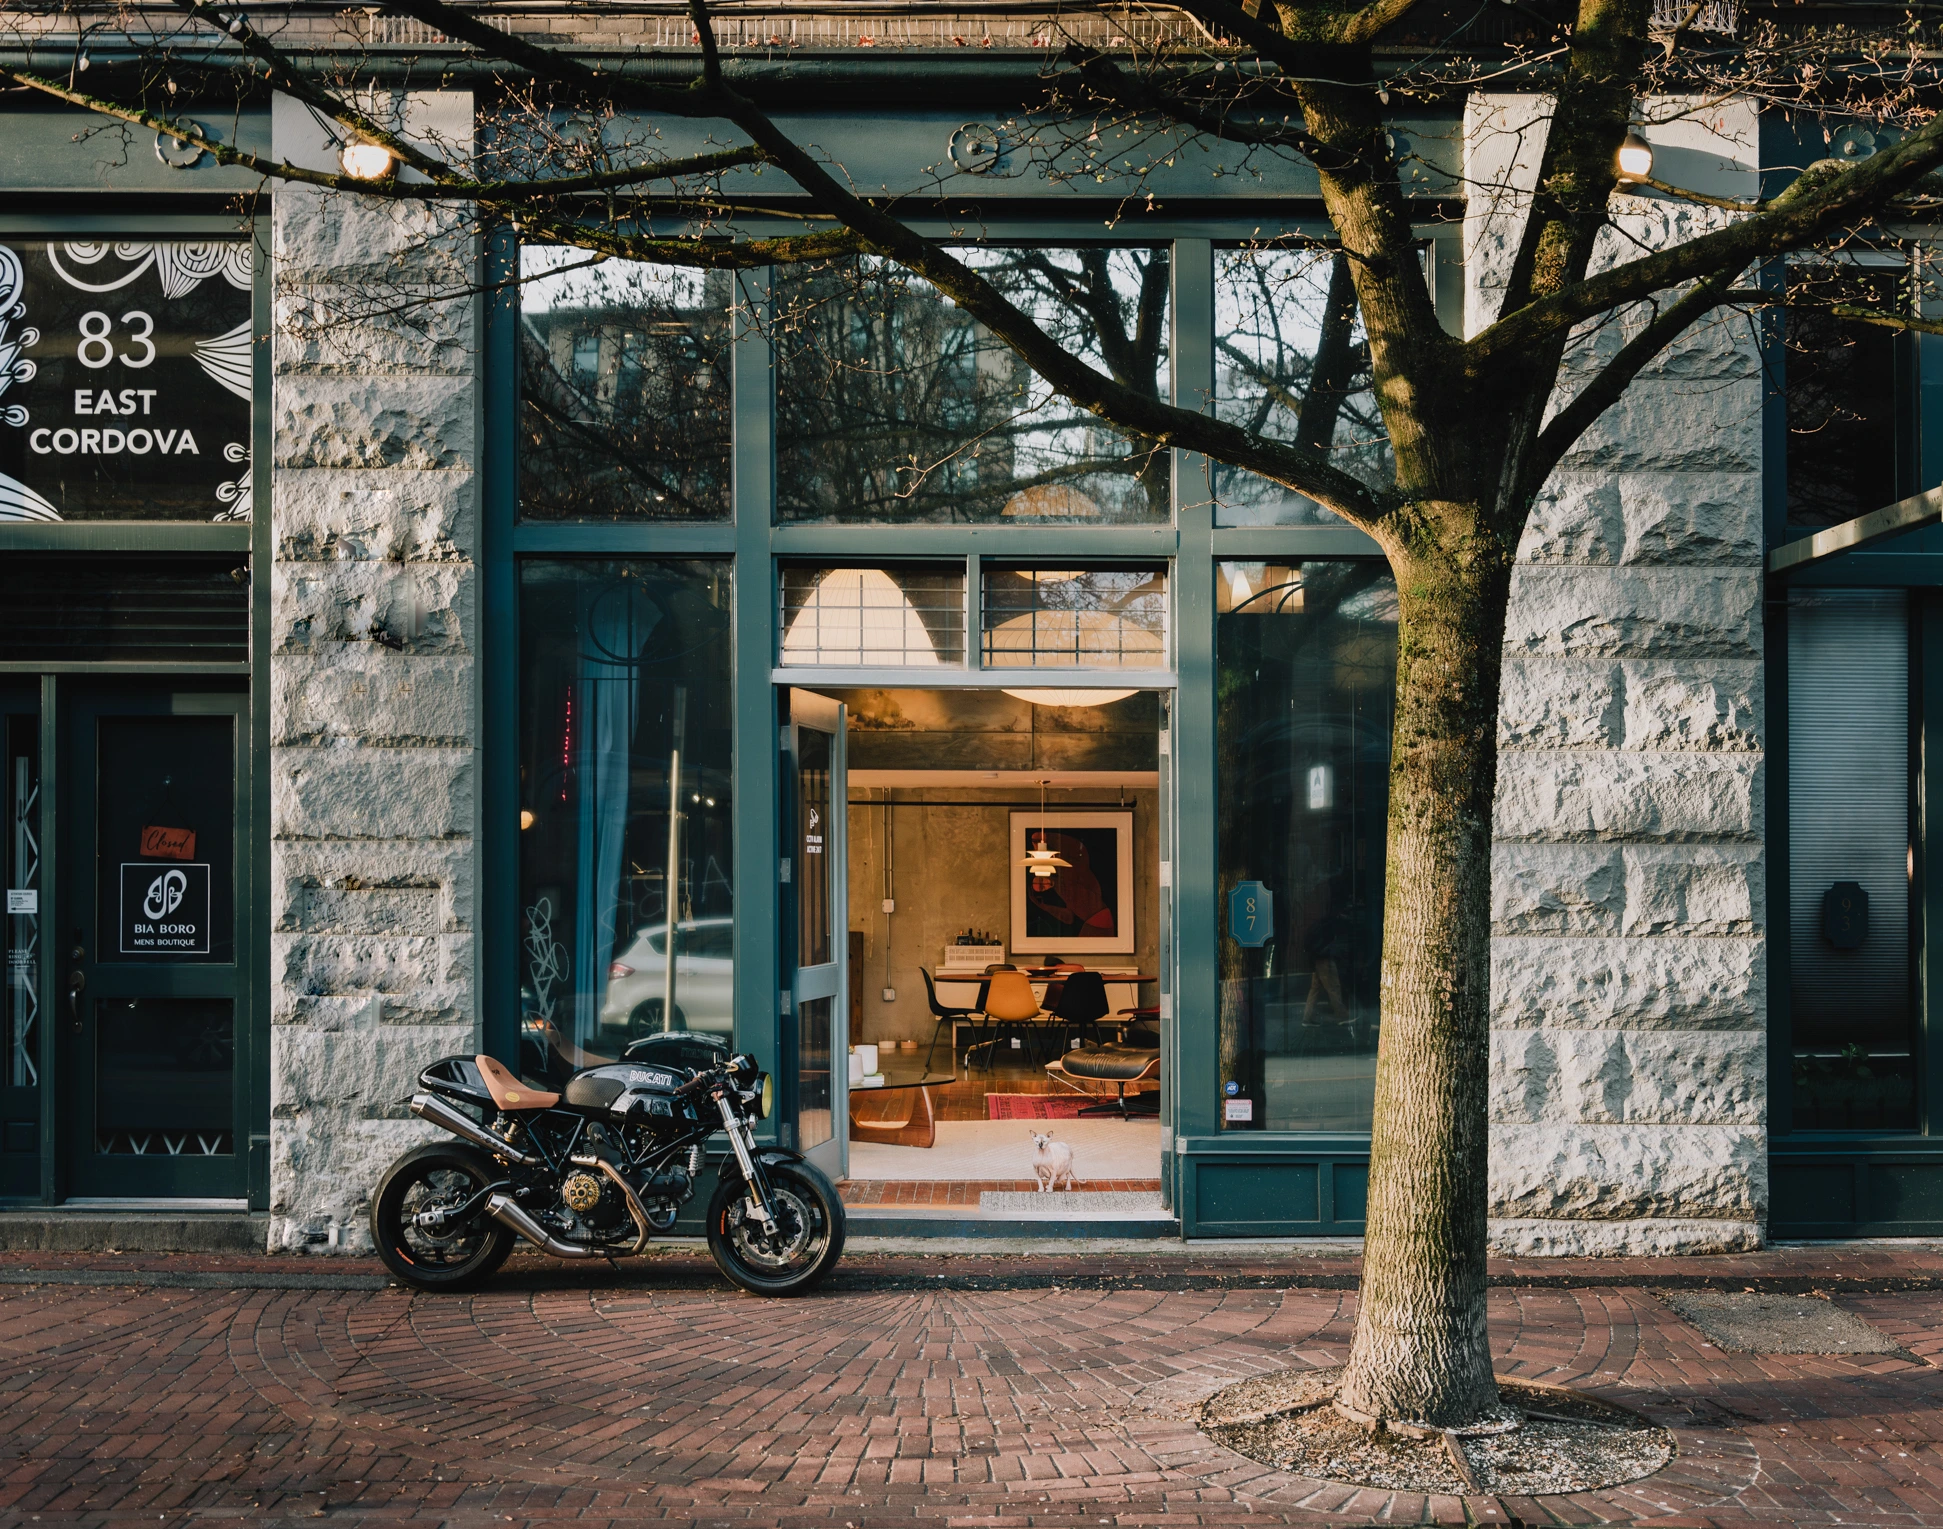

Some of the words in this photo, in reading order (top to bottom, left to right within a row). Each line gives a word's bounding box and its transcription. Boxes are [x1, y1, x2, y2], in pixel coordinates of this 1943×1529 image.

[76, 310, 156, 369] 83
[74, 389, 157, 415] EAST
[29, 428, 200, 455] CORDOVA
[146, 829, 190, 853] Closed
[134, 924, 155, 934] BIA
[159, 924, 196, 934] BORO
[157, 939, 195, 948] BOUTIQUE
[629, 1069, 673, 1086] DUCATI
